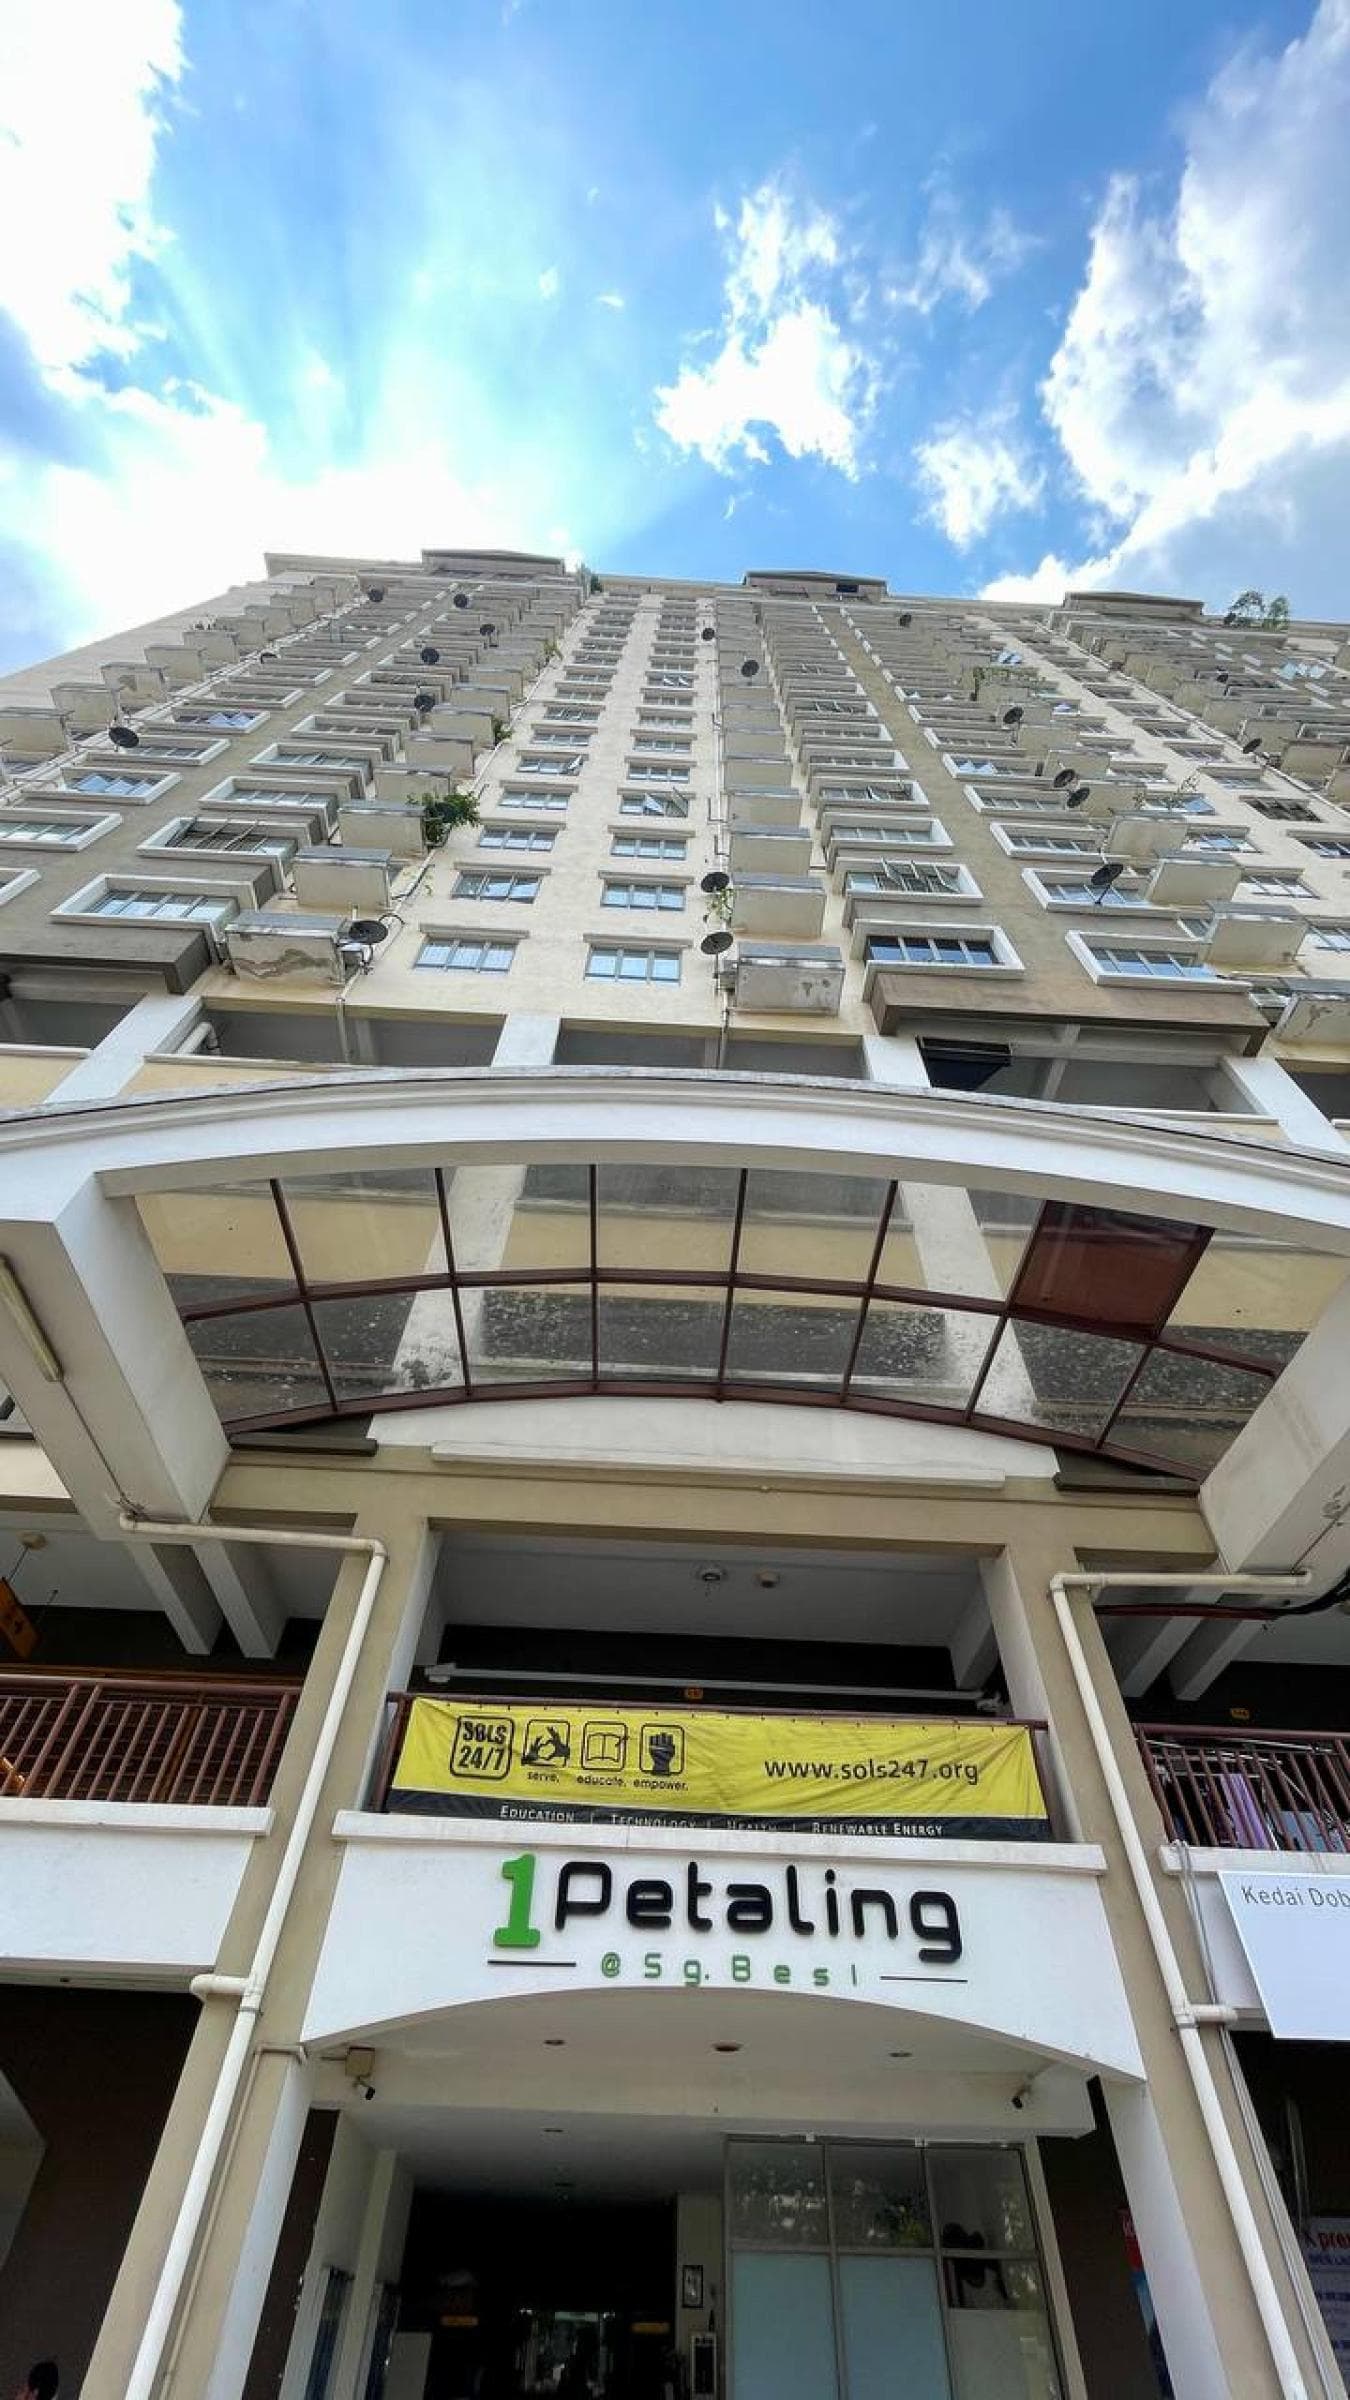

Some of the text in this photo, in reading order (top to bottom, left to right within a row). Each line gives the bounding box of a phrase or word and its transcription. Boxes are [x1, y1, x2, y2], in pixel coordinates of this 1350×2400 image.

[462, 1720, 507, 1745] SOLS
[457, 1745, 505, 1771] 24/7
[764, 1759, 978, 1785] www.sols247.org
[1241, 1886, 1304, 1905] Kedai
